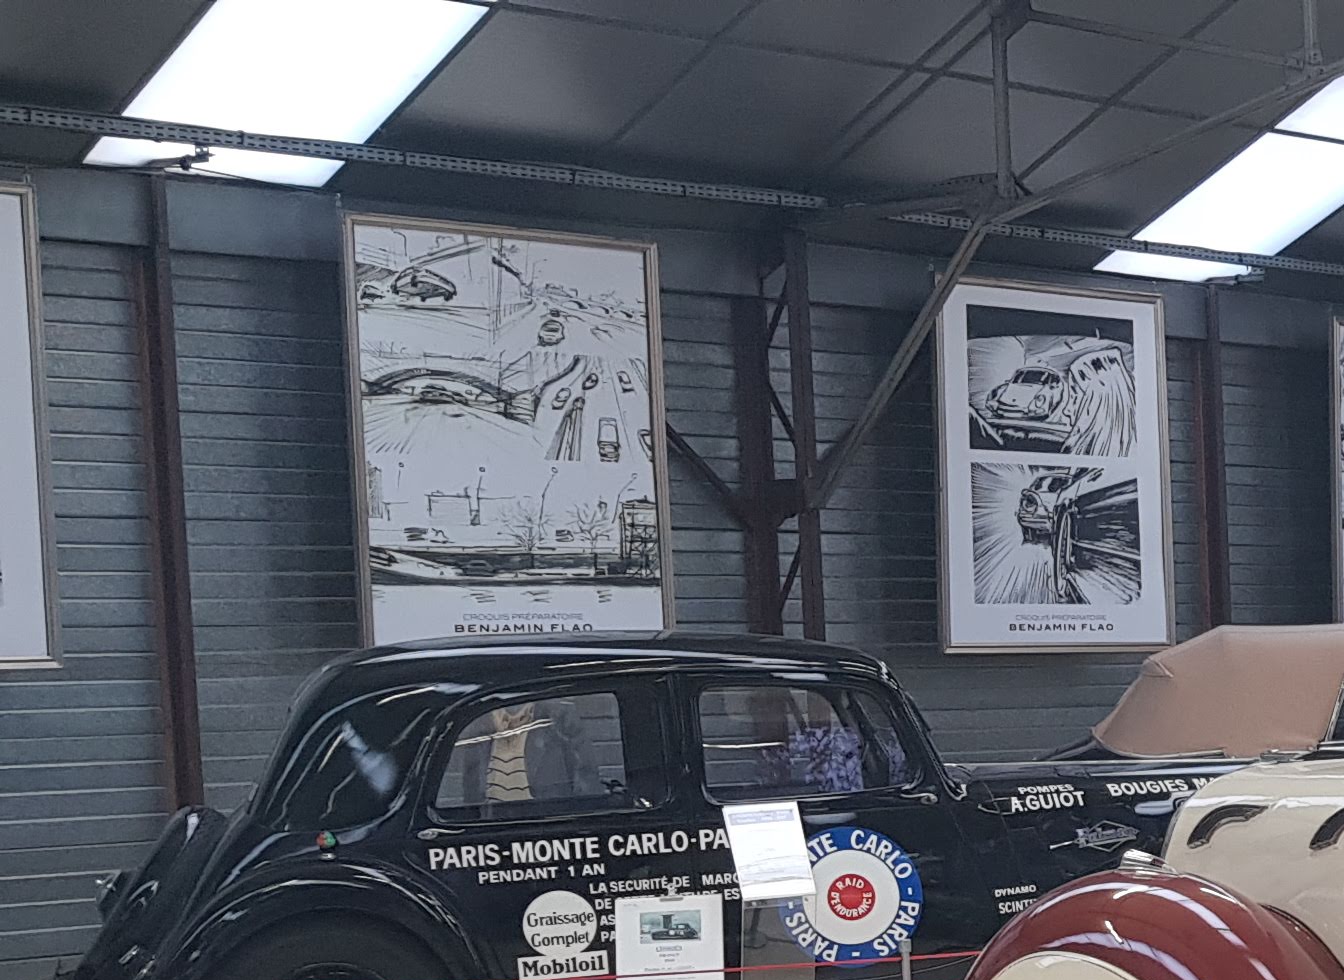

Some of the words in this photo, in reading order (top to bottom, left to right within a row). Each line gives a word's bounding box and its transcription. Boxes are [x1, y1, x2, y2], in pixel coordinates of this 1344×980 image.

[454, 623, 544, 633] BENJAMIN
[1008, 623, 1076, 632] BENJAMIN
[1081, 623, 1114, 631] FLAO
[1017, 783, 1075, 795] POMPES
[1105, 778, 1189, 798] BOUGIES
[1010, 791, 1085, 813] A.GUIOT
[850, 829, 913, 879] CARLO
[478, 866, 558, 884] PENDANT
[567, 866, 576, 878] 1
[582, 863, 605, 876] AN
[589, 882, 608, 894] LA
[672, 875, 691, 888] DE
[835, 877, 865, 891] RAID
[995, 884, 1037, 897] DYNAMO
[594, 898, 613, 910] DE
[527, 909, 595, 929] Graissage
[530, 932, 590, 950] Complet
[521, 954, 606, 978] Mobiloil
